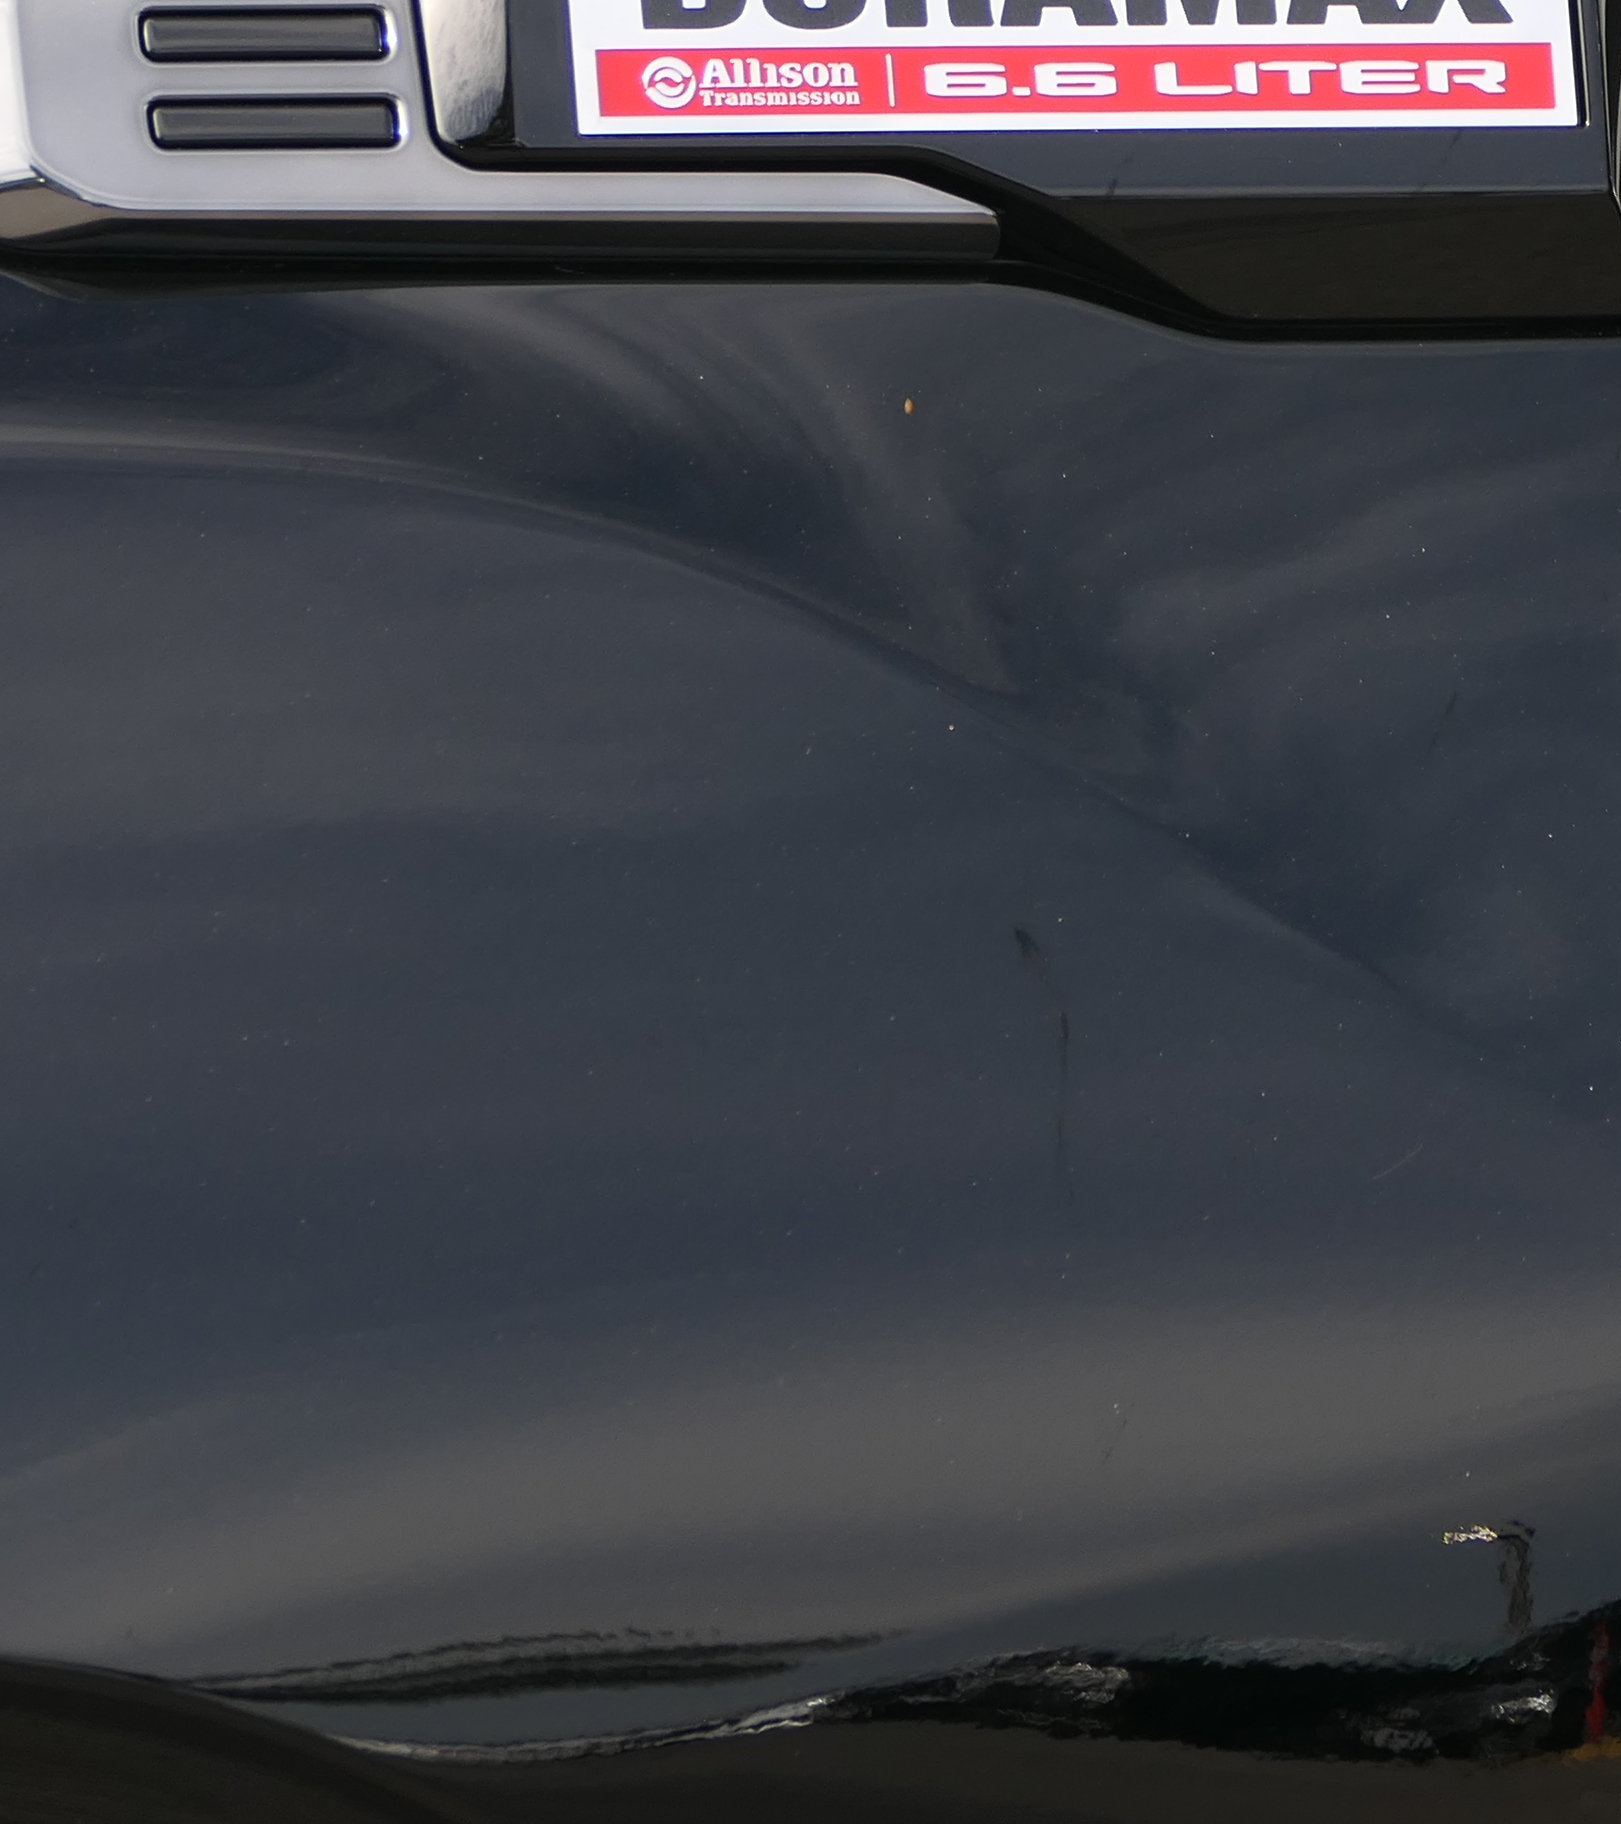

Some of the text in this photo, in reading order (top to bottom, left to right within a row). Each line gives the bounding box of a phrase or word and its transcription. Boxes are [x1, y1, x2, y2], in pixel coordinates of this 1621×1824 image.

[698, 57, 859, 89] Allison
[923, 59, 1507, 97] 6.6 LITER
[698, 89, 861, 108] Transmission
